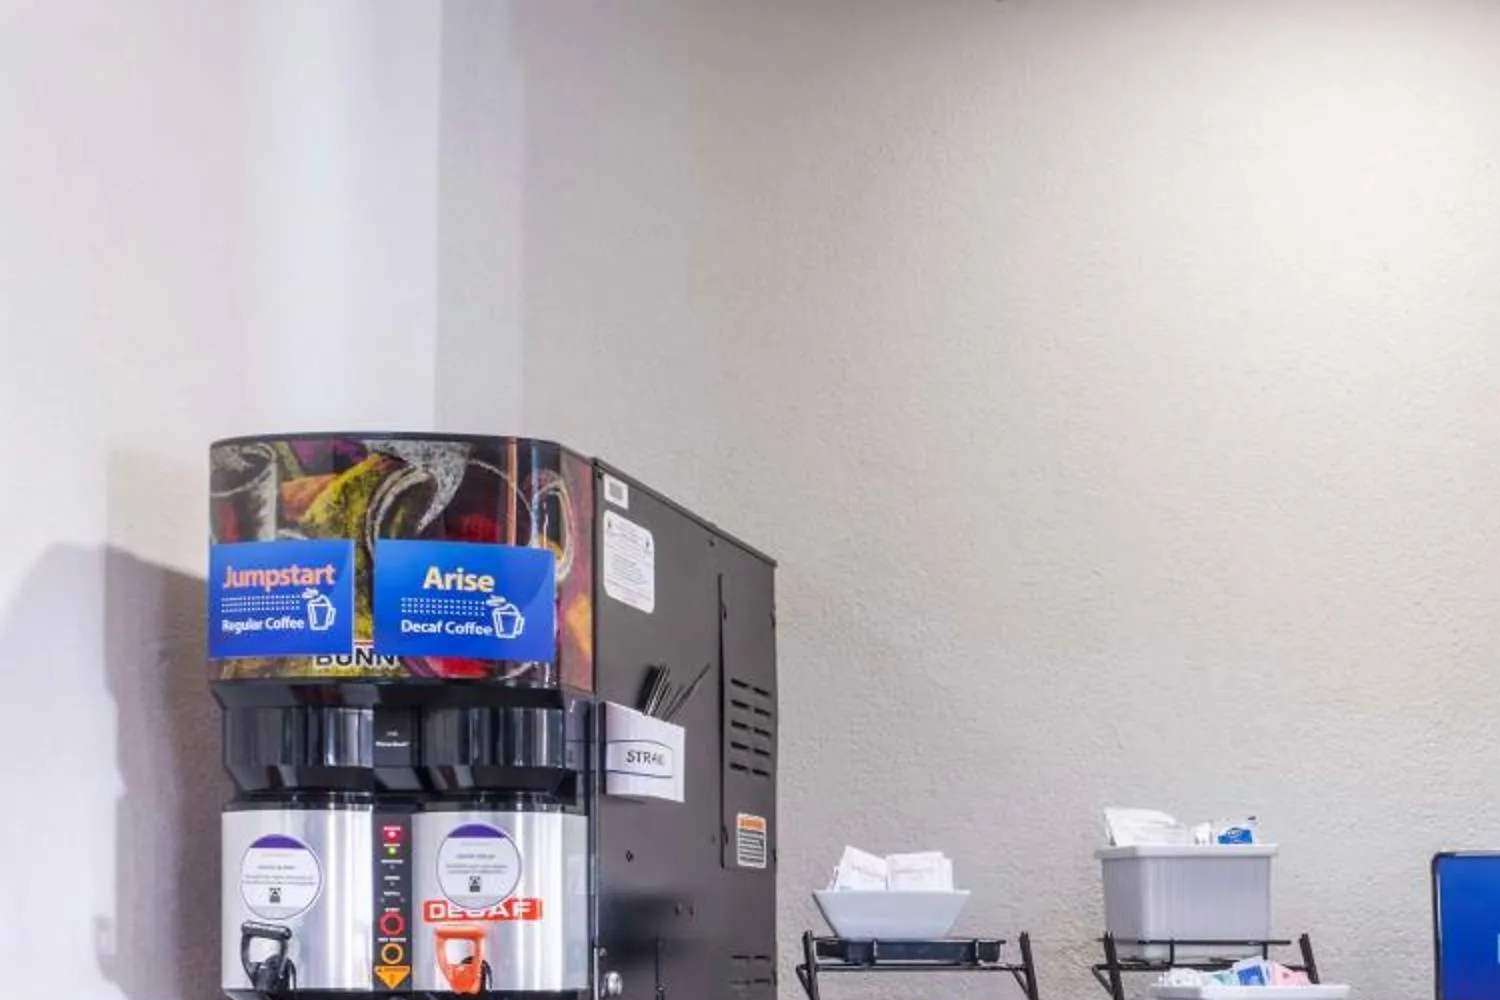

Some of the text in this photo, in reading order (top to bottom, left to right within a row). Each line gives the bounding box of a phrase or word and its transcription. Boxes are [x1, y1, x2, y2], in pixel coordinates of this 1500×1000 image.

[222, 564, 336, 592] Jumpstart
[423, 565, 496, 592] Arise
[221, 616, 305, 635] Regular Coffee
[400, 619, 494, 636] Decaf Coffee
